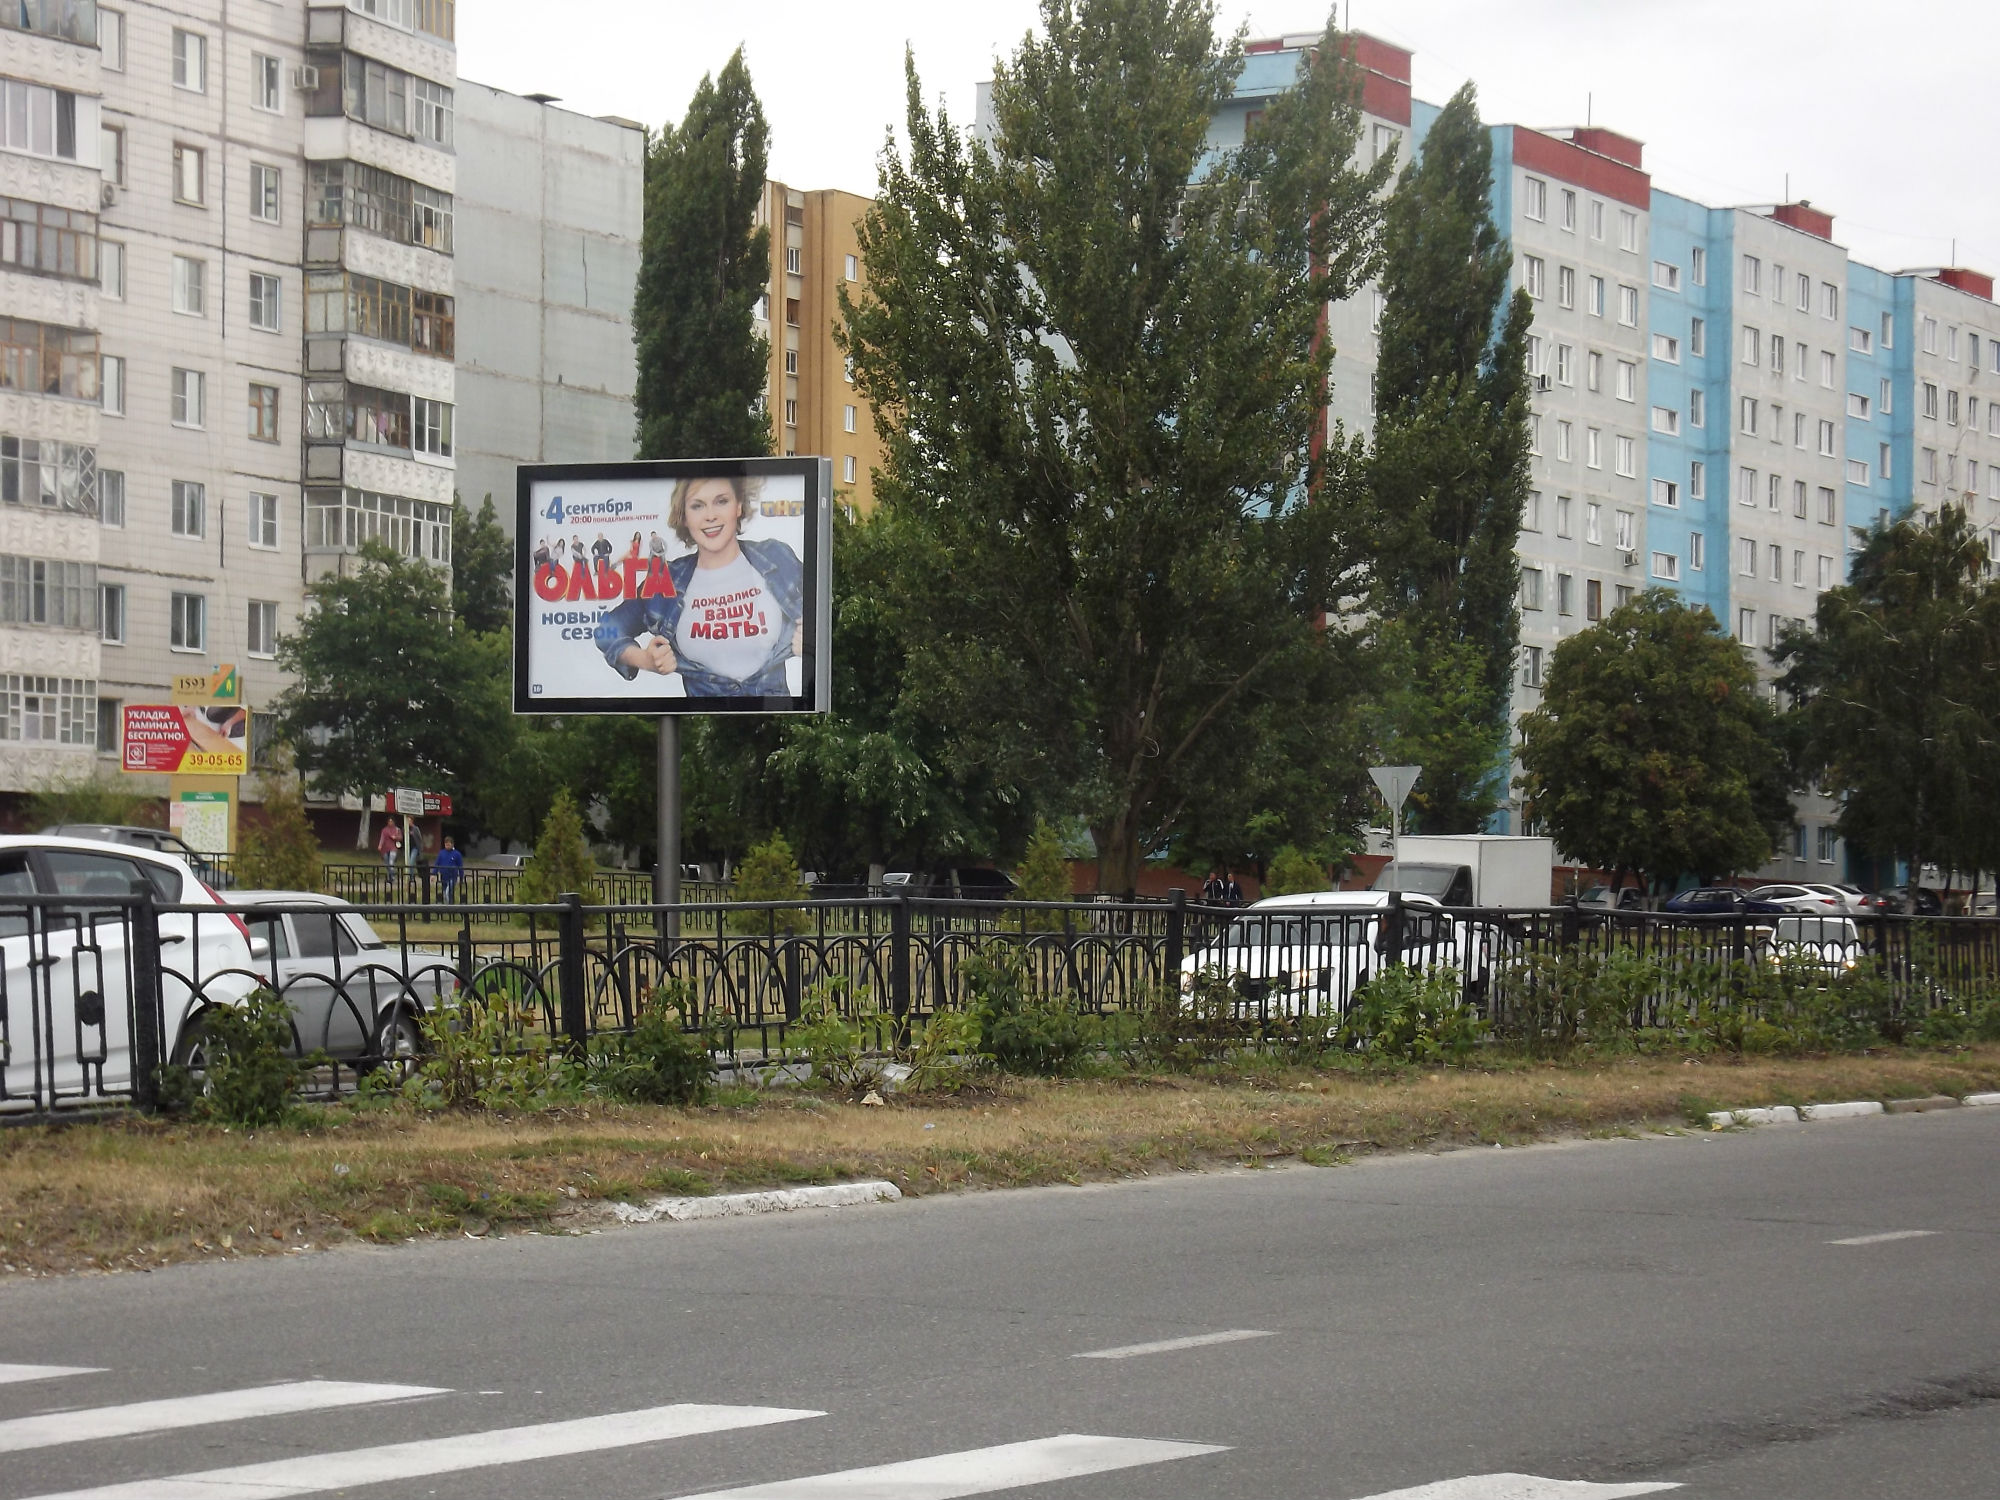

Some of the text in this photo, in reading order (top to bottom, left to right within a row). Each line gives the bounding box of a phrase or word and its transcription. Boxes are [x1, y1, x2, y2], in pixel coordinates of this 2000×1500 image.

[545, 496, 566, 525] 4
[565, 498, 633, 516] сентября
[570, 515, 592, 524] 20:00
[534, 556, 677, 602] ОЛЬГА
[692, 587, 761, 609] дождались
[541, 605, 609, 625] новый
[705, 602, 753, 621] вашу
[561, 626, 618, 641] сезон
[690, 611, 768, 640] мать!
[180, 678, 206, 689] 1593
[128, 710, 171, 720] УКЛАДКА
[128, 721, 180, 730] ЛАМИНАТА
[190, 755, 242, 766] 39-05-65
